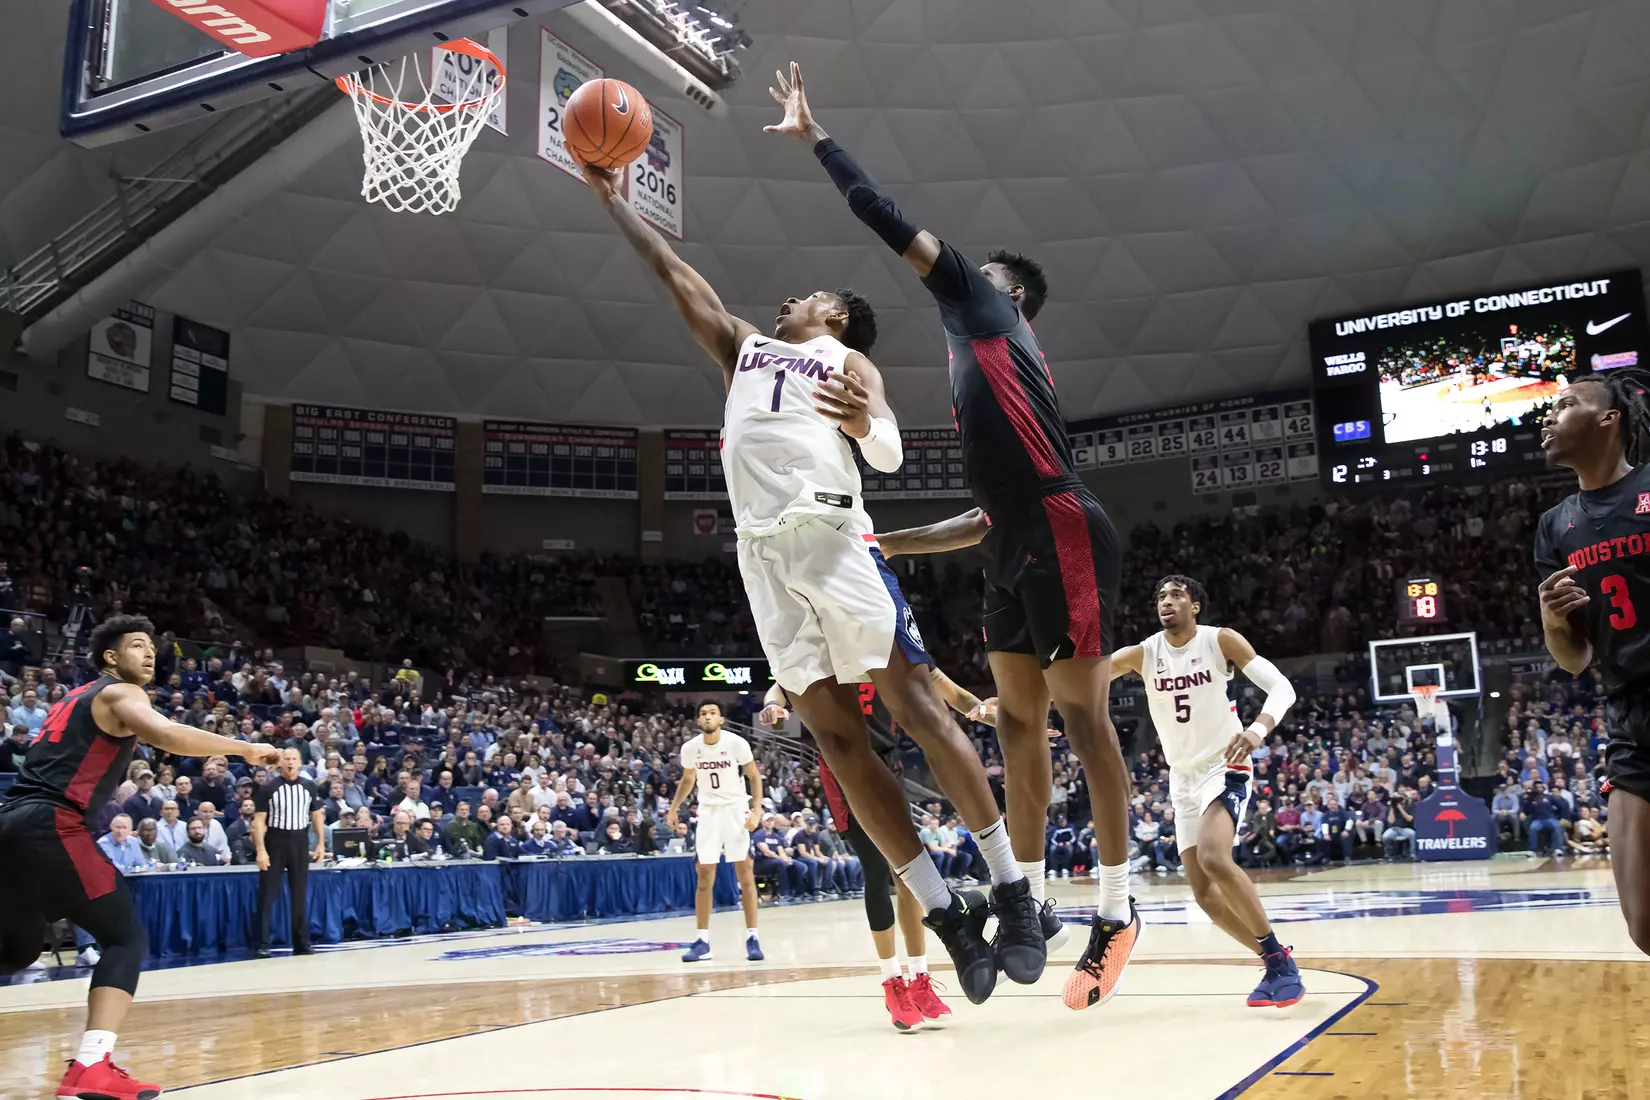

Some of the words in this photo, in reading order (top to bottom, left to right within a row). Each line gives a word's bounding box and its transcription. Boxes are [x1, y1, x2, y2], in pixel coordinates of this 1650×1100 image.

[445, 69, 482, 97] NATION
[636, 164, 676, 204] 2016
[637, 189, 675, 219] NATIONAL
[633, 201, 678, 233] CHAMPIONS
[1335, 305, 1442, 336] UNIVERSITY
[1445, 300, 1471, 318] OF
[1474, 279, 1610, 313] CONNECTICUT
[739, 352, 835, 382] UCONN
[1324, 352, 1366, 366] WELLS
[1326, 362, 1367, 377] FARGO
[770, 369, 786, 413] 1
[296, 405, 319, 416] BIG
[326, 408, 360, 420] EAST
[367, 412, 454, 428] CONFERENCE
[1117, 413, 1150, 425] UCONN
[1154, 405, 1198, 418] HUSKIES
[1202, 402, 1215, 411] OF
[1220, 397, 1255, 409] HONOR
[1288, 417, 1311, 433] 42
[1333, 420, 1365, 434] CBS
[1192, 431, 1215, 447] 42
[1223, 427, 1246, 442] 44
[1131, 440, 1153, 455] 22
[1161, 435, 1184, 452] 25
[1075, 449, 1088, 463] C
[1107, 445, 1117, 459] 9
[1195, 470, 1218, 486] 24
[1228, 466, 1247, 482] 13
[1260, 462, 1281, 478] 22
[1332, 464, 1348, 483] 12
[1600, 574, 1637, 631] 3
[1154, 669, 1212, 692] UCONN
[1118, 697, 1134, 706] 113
[1174, 694, 1191, 723] 5
[696, 760, 731, 770] UCONN
[710, 772, 720, 789] 0
[1416, 837, 1487, 850] TRAVELERS
